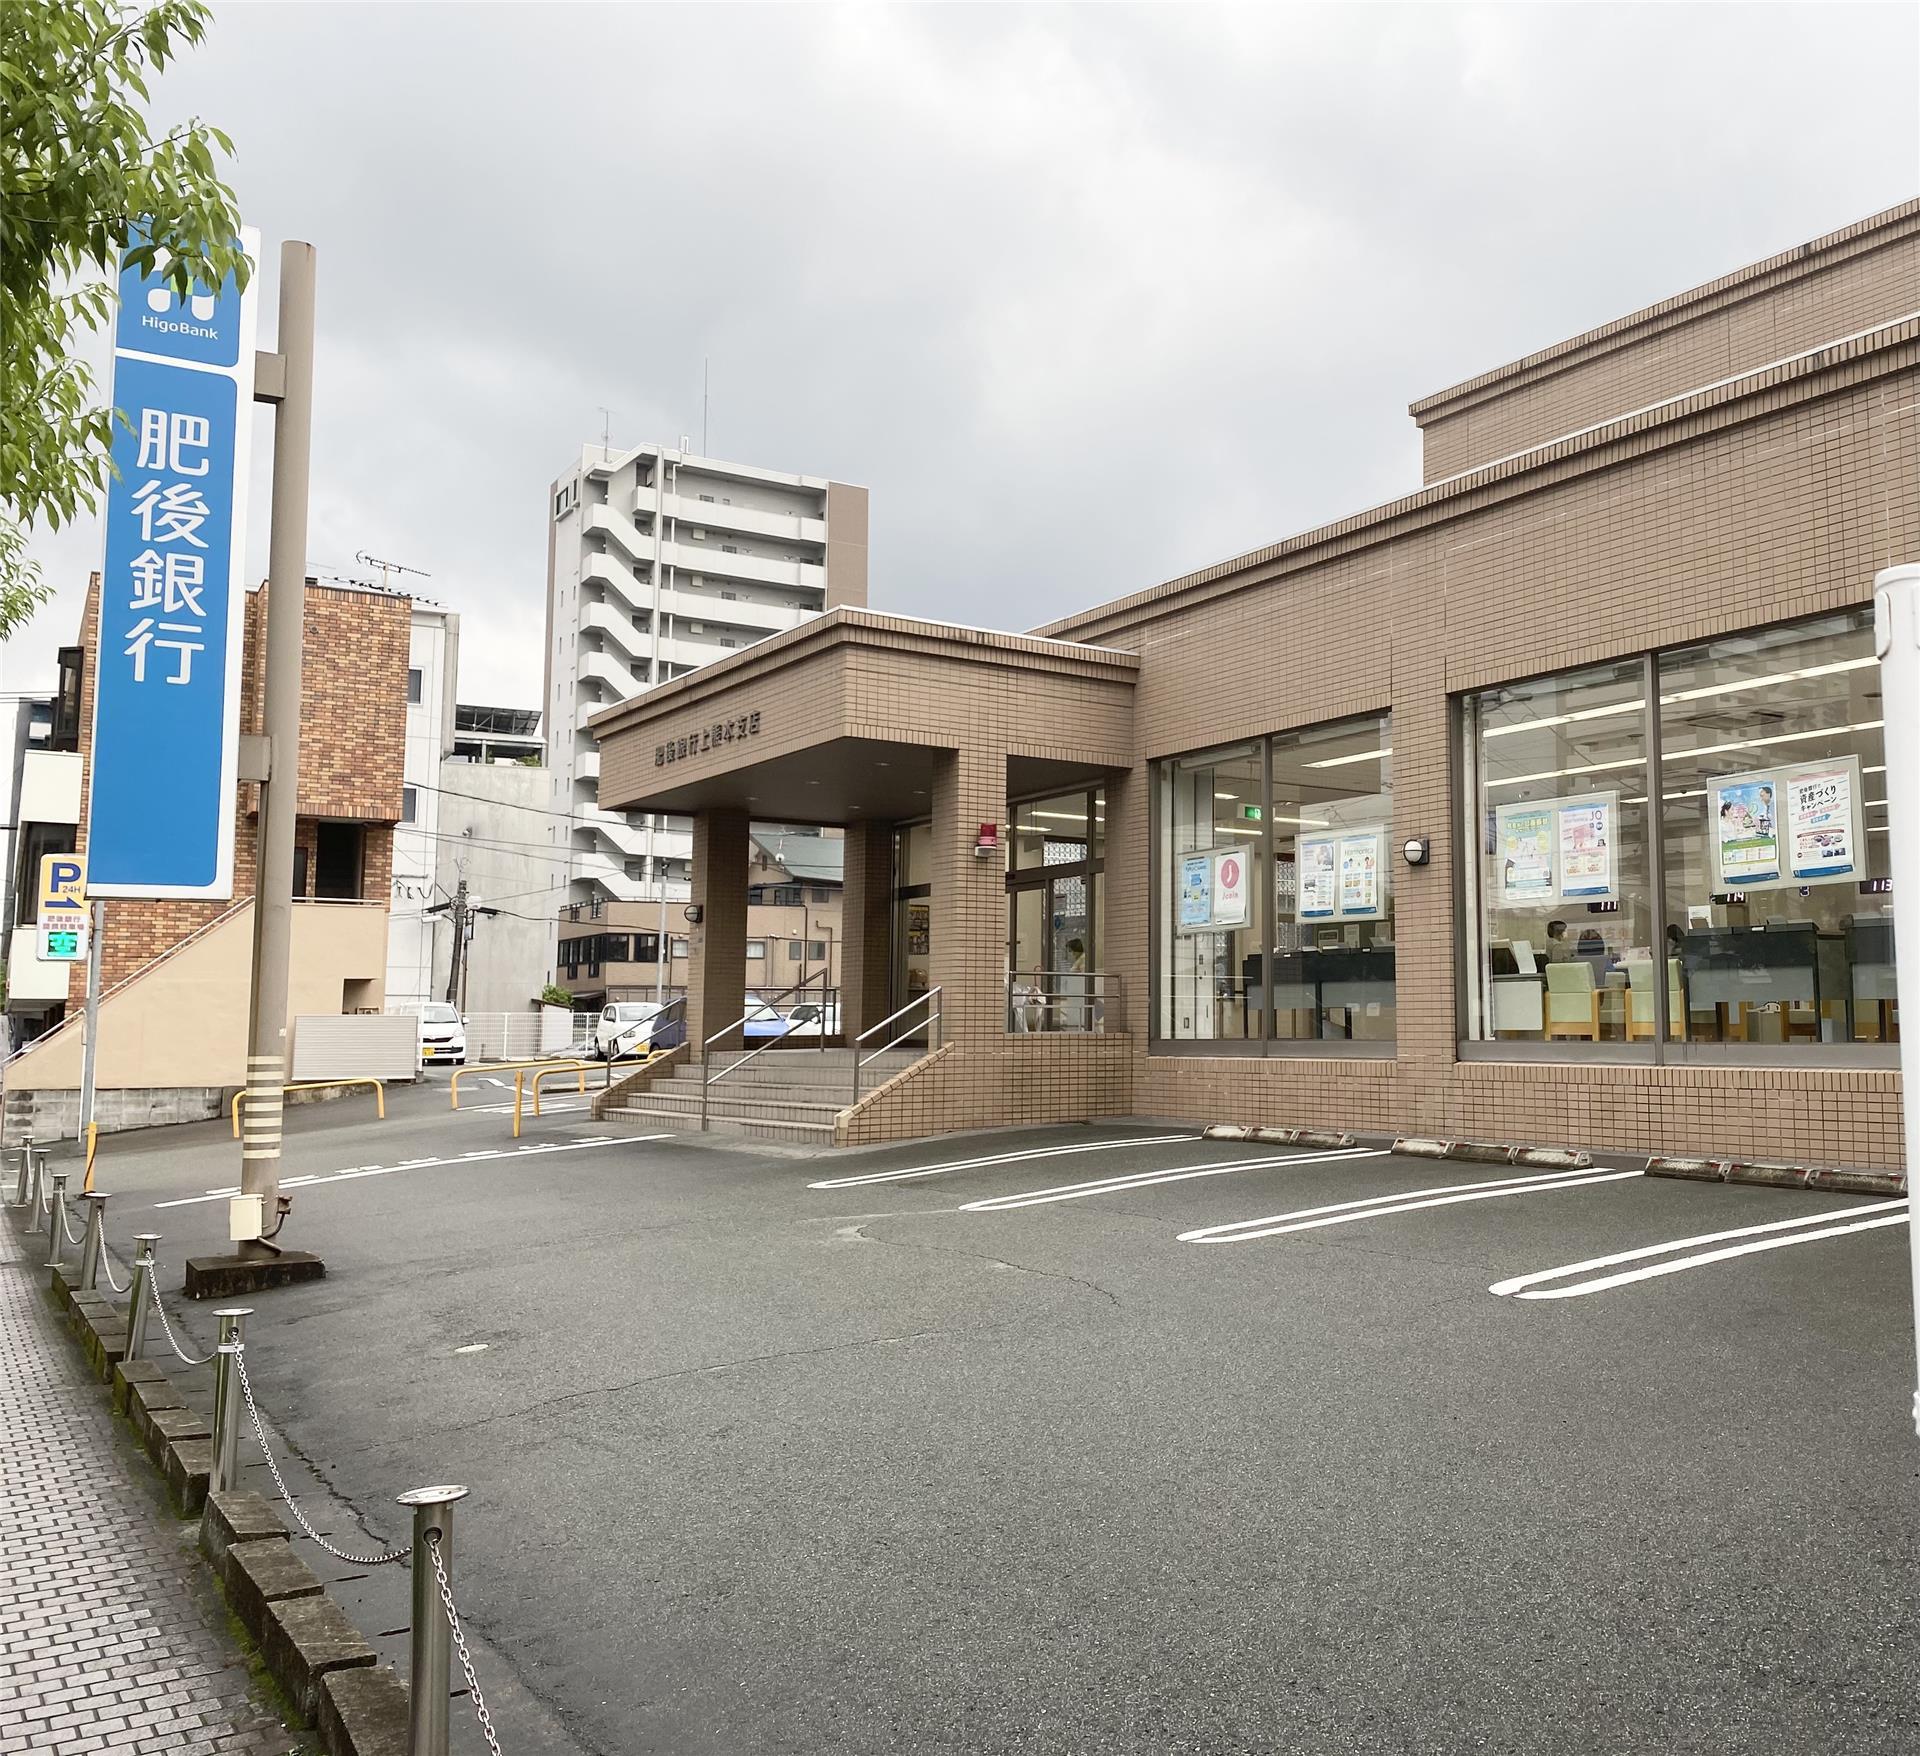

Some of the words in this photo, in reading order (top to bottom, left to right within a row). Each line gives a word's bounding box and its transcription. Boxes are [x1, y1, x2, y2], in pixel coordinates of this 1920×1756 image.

[142, 315, 218, 340] HigoBank
[123, 407, 211, 685] 肥後銀行
[655, 710, 761, 766] 肥後銀行上熊本支店
[1800, 785, 1836, 804] 資産づくり
[1801, 797, 1837, 811] キャンペーン
[50, 862, 81, 893] P
[62, 885, 81, 894] 24H
